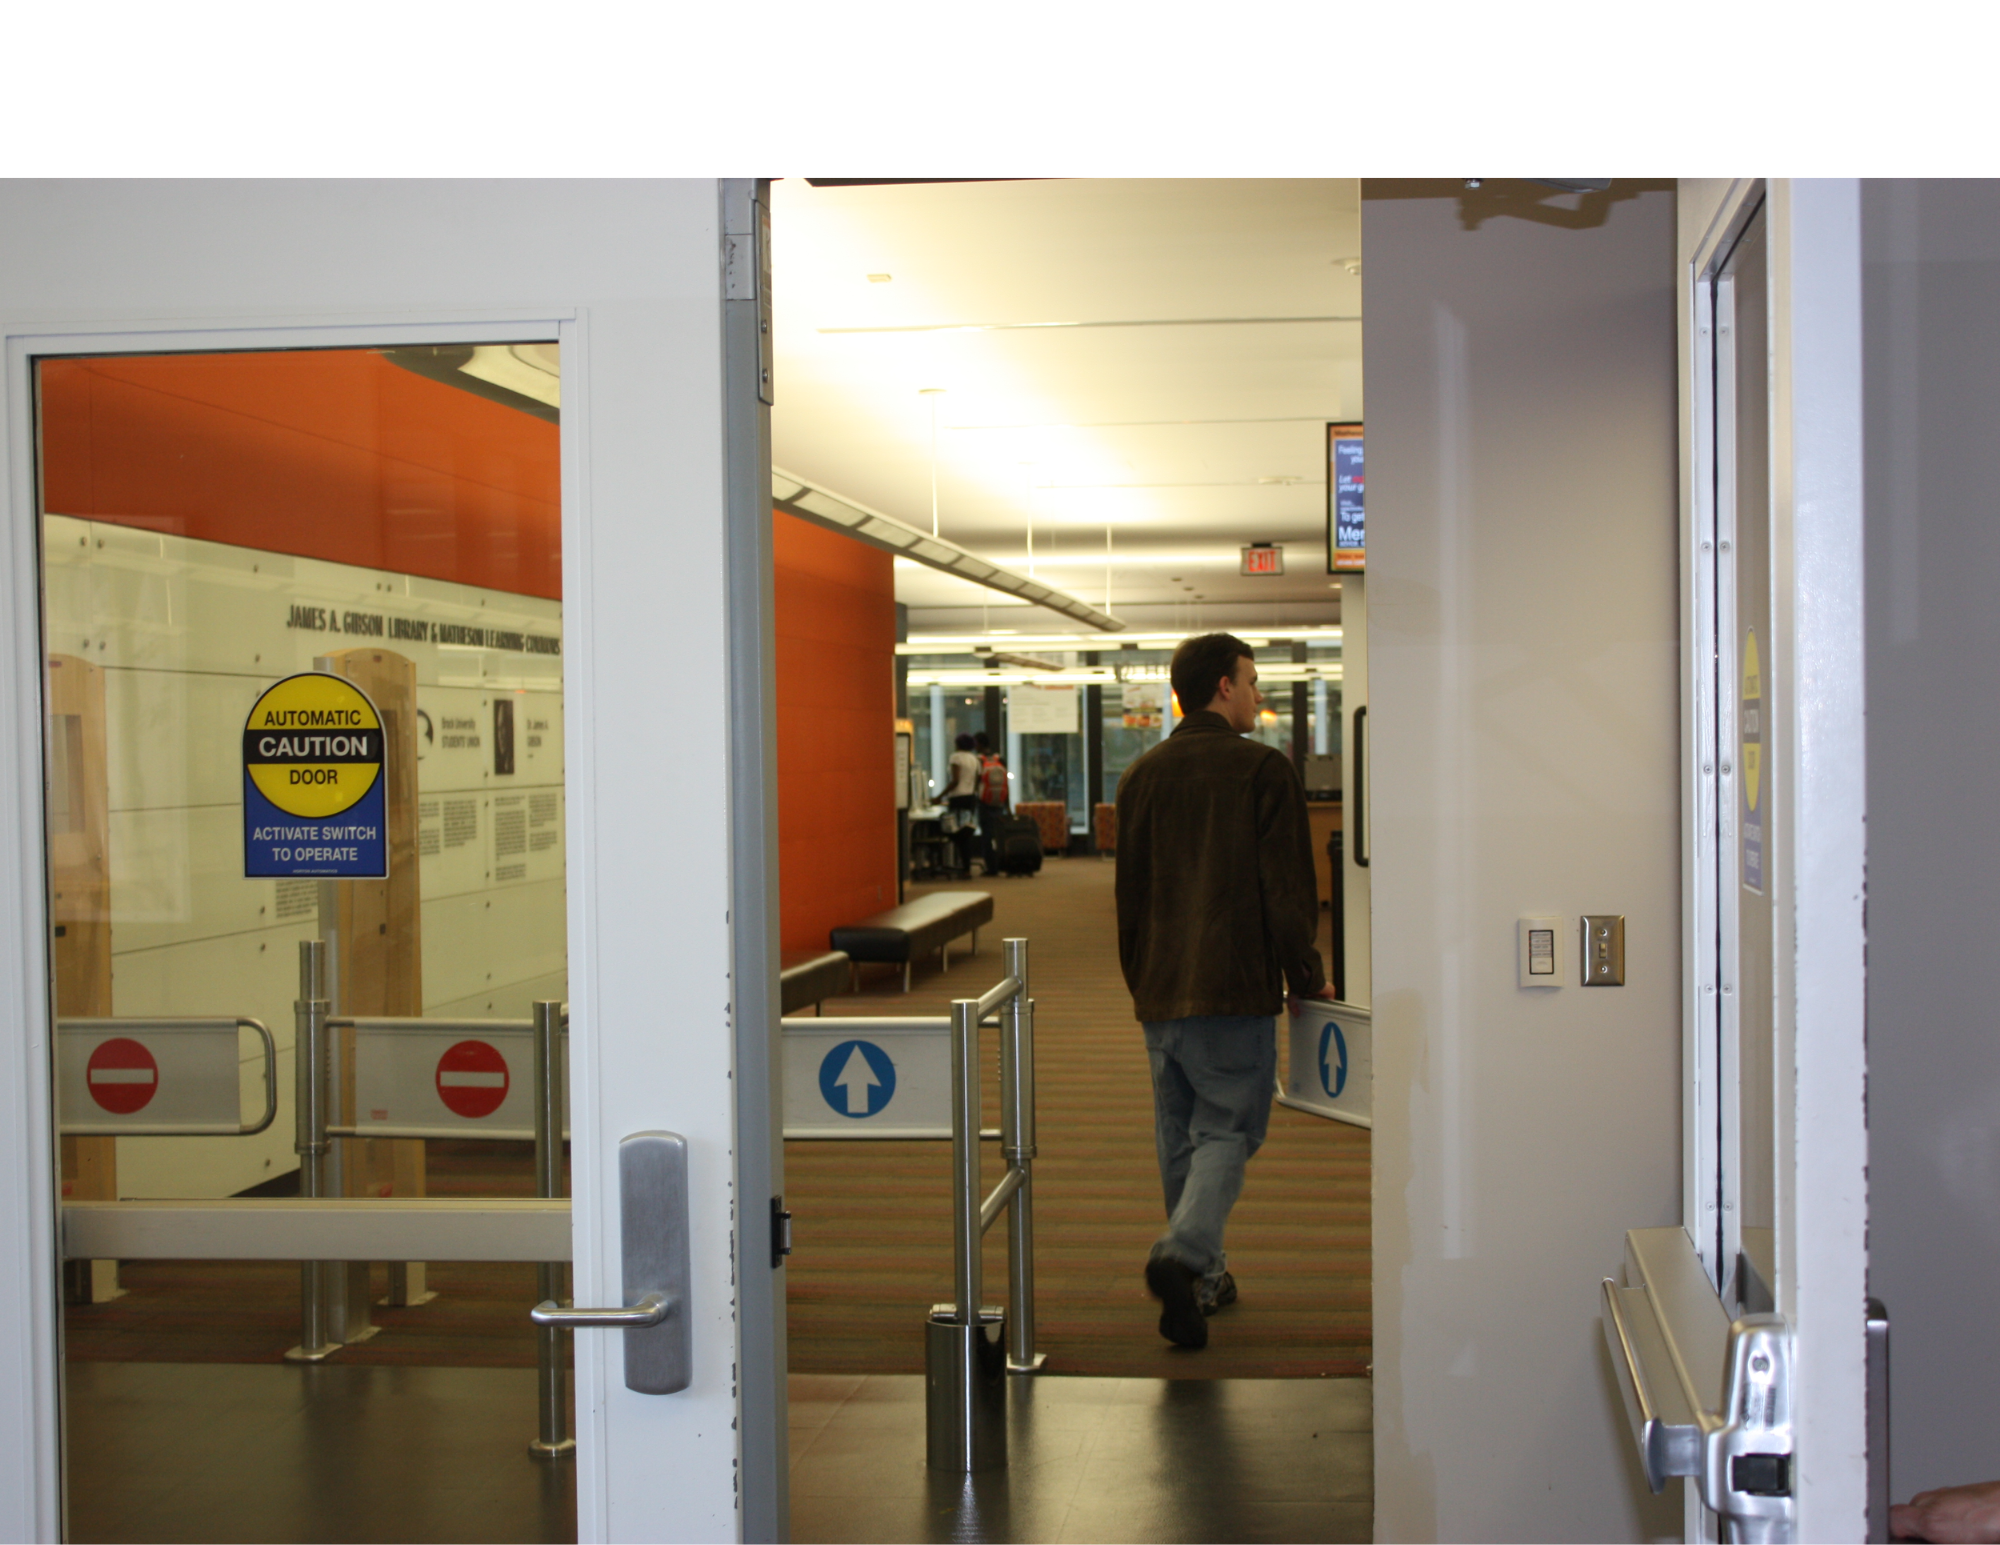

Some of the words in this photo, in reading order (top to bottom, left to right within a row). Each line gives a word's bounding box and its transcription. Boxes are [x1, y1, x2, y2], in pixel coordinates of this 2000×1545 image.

[1338, 474, 1351, 483] Let
[1248, 550, 1276, 572] EXIT
[286, 604, 326, 632] JAMES
[329, 609, 341, 633] A.
[343, 610, 383, 638] GIBSON
[388, 616, 429, 642] LIBRARY
[485, 628, 525, 652] LEARNING
[264, 710, 361, 726] AUTOMATIC
[258, 736, 368, 757] CAUTION
[290, 769, 338, 785] DOOR
[253, 827, 319, 841] ACTIVATE
[322, 826, 376, 840] SWITCH
[272, 848, 291, 861] TO
[294, 847, 358, 861] OPERATE
